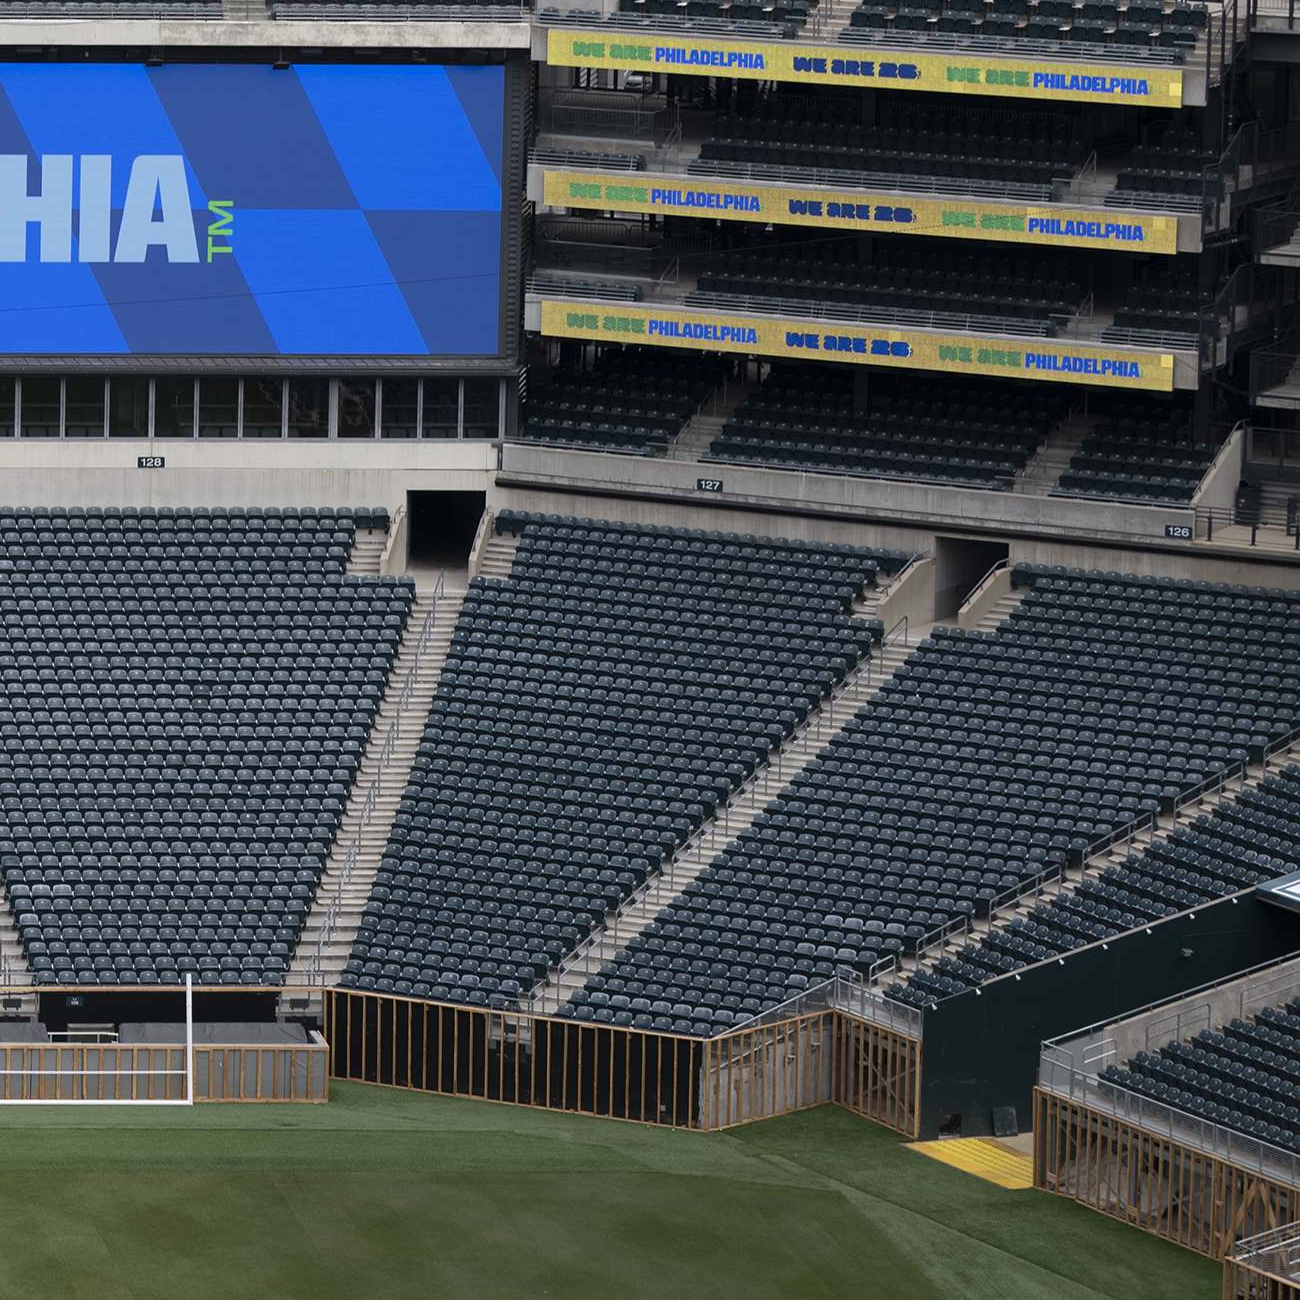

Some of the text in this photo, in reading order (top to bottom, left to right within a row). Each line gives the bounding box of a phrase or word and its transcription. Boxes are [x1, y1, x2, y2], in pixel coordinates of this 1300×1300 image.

[573, 41, 606, 58] WE
[609, 44, 652, 61] ARE
[655, 47, 765, 70] PHILADELPHIA
[793, 56, 827, 73] WE
[830, 59, 874, 77] ARE
[878, 62, 917, 80] 26
[946, 66, 980, 83] WE
[985, 69, 1030, 87] ARE
[1033, 72, 1149, 95] PHILADELPHIA
[569, 182, 602, 200] WE
[605, 185, 648, 203] ARE
[651, 188, 761, 212] PHILADELPHIA
[789, 199, 823, 216] WE
[826, 202, 870, 220] ARE
[874, 205, 913, 223] 26
[942, 211, 976, 229] WE
[980, 214, 1025, 232] ARE
[1028, 217, 1144, 241] PHILADELPHIA
[566, 313, 599, 330] WE
[602, 315, 645, 333] ARE
[649, 320, 758, 344] PHILADELPHIA
[785, 331, 820, 350] WE
[823, 334, 866, 353] ARE
[871, 339, 909, 357] 26
[938, 345, 973, 362] WE
[976, 348, 1022, 367] ARE
[1024, 353, 1140, 378] PHILADELPHIA
[140, 458, 162, 467] 128
[700, 480, 720, 490] 127
[1168, 526, 1190, 537] 126
